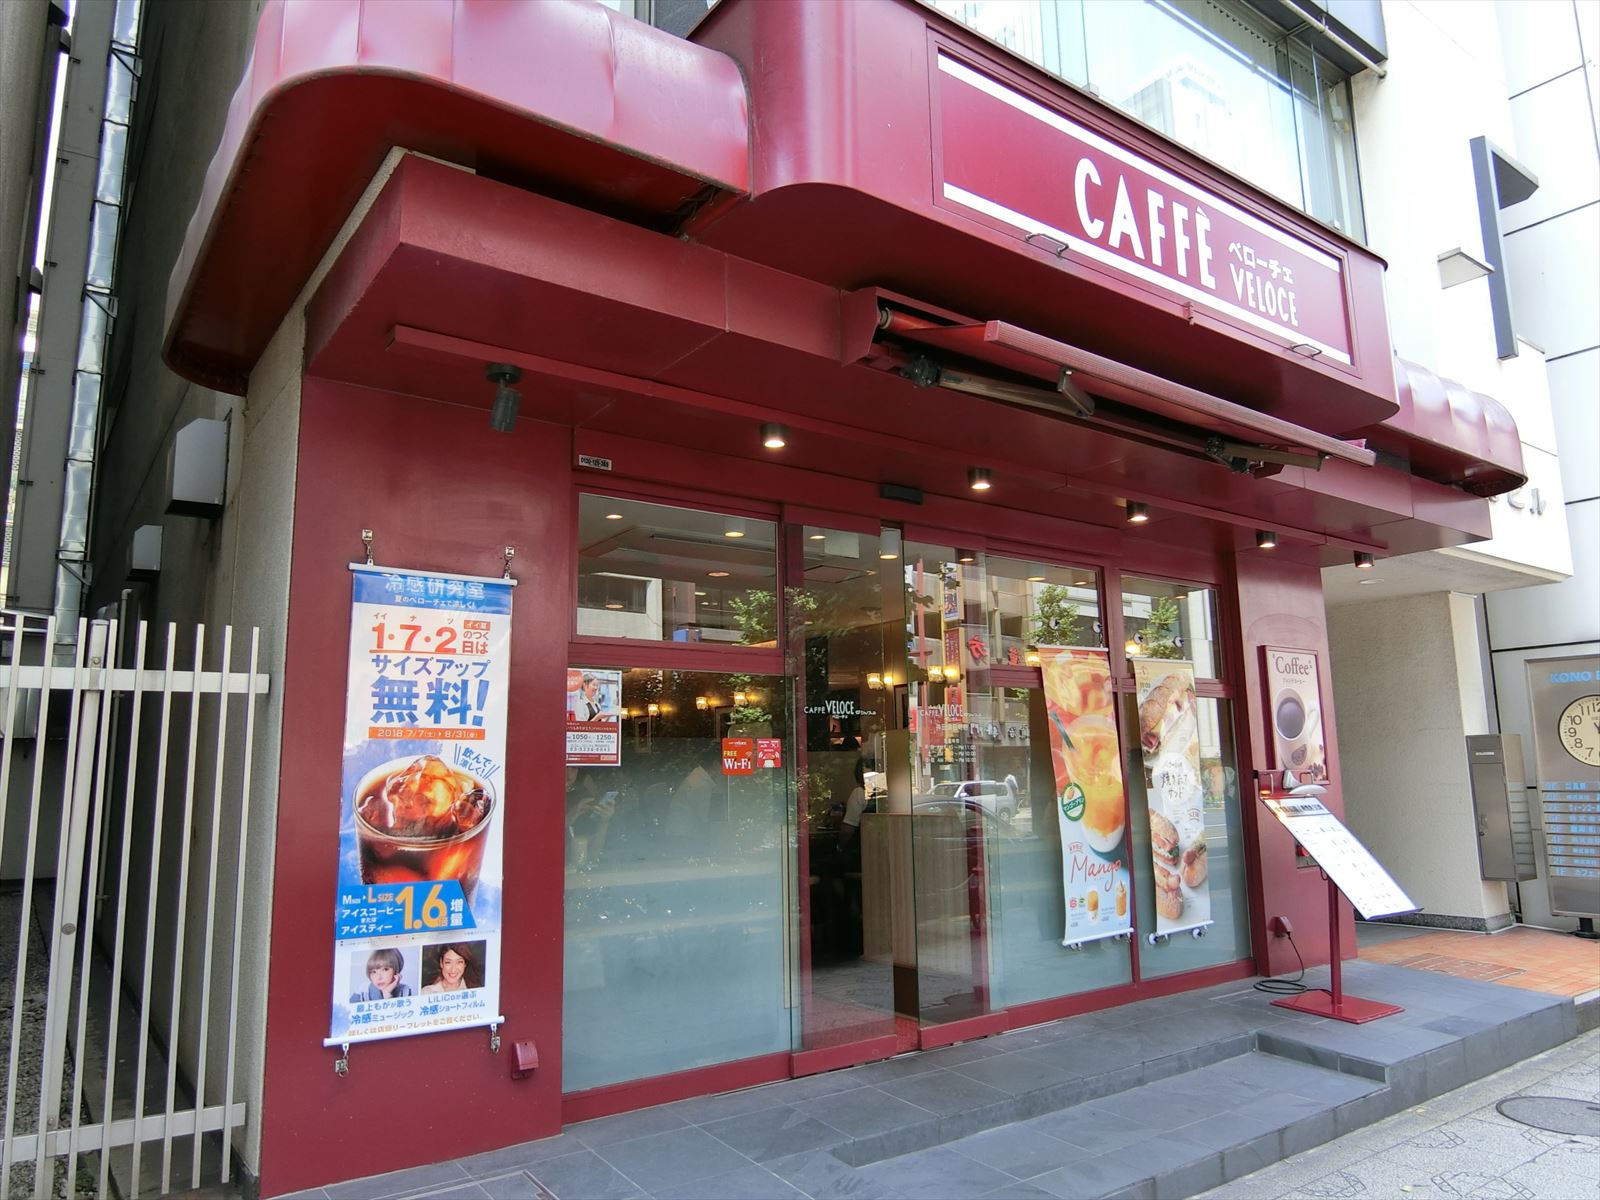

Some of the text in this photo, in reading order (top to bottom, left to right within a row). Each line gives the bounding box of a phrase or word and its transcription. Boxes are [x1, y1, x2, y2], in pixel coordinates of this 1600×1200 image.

[1228, 242, 1295, 284] ベローチェ
[1229, 263, 1299, 327] VELOCE
[463, 630, 489, 640] のつく
[462, 641, 489, 654] 日は
[371, 654, 491, 678] サイズアップ
[1275, 656, 1309, 676] Coffee
[1551, 671, 1592, 683] KONO
[370, 675, 490, 727] 無料!
[825, 700, 854, 715] VELOCE
[1570, 715, 1582, 725] 10
[1568, 727, 1577, 737] 9
[1574, 737, 1583, 748] 8
[462, 747, 492, 767] 飲んで
[1585, 747, 1594, 757] 7
[723, 757, 751, 769] Wi-Fi
[1070, 855, 1121, 892] Mango
[342, 907, 403, 918] アイスコーヒー
[395, 884, 447, 929] 1.6
[341, 924, 392, 935] アイスティー
[419, 1000, 485, 1016] 冷感ショートフィルム
[351, 1010, 414, 1025] 冷感ミュージック
